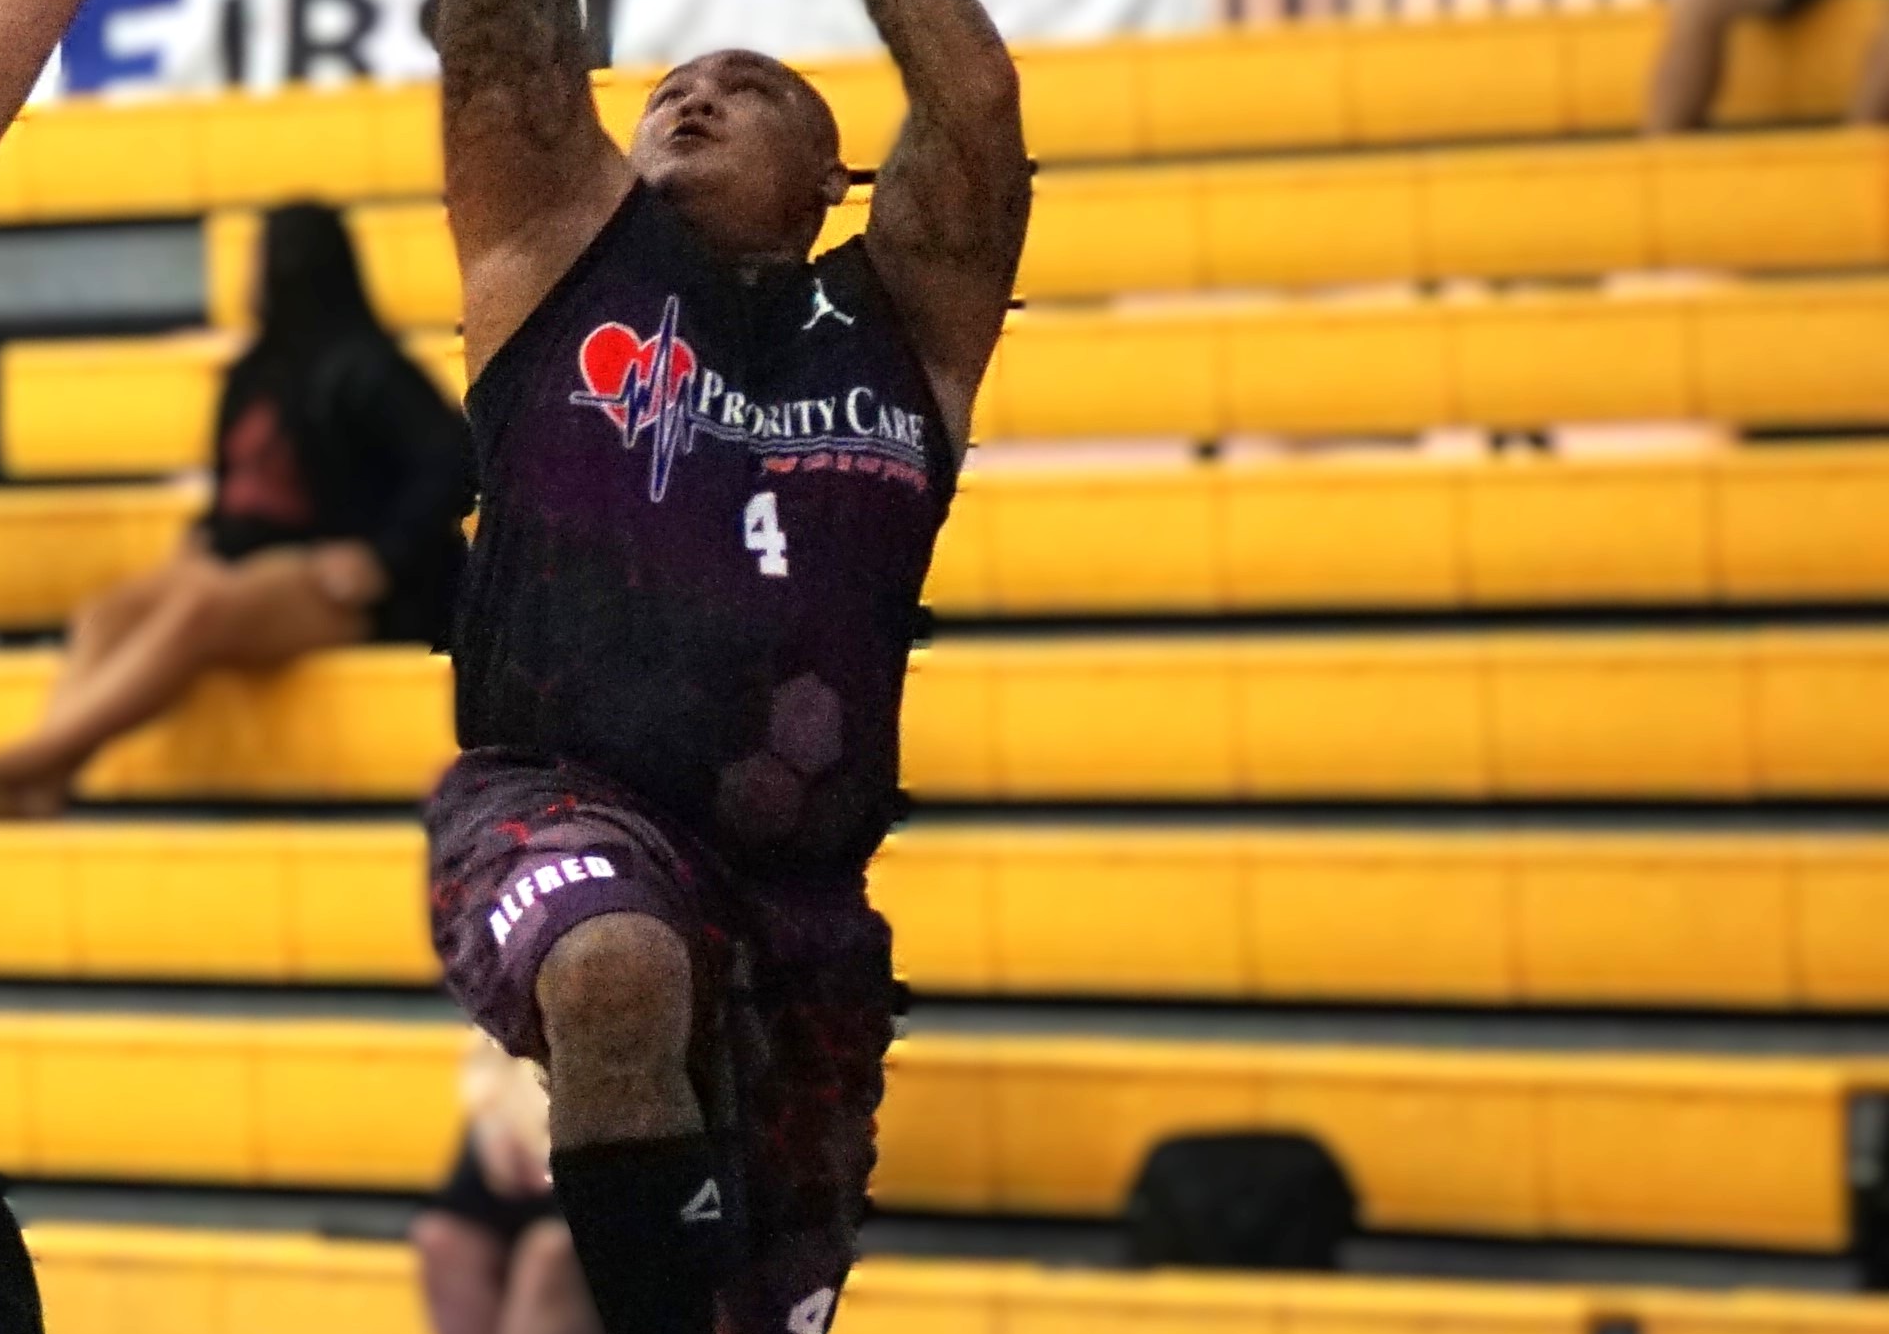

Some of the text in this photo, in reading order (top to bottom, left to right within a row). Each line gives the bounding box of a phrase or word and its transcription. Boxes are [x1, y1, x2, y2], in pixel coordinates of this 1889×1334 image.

[846, 385, 926, 451] CARE
[743, 490, 789, 578] 4
[489, 855, 616, 946] ALFRED
